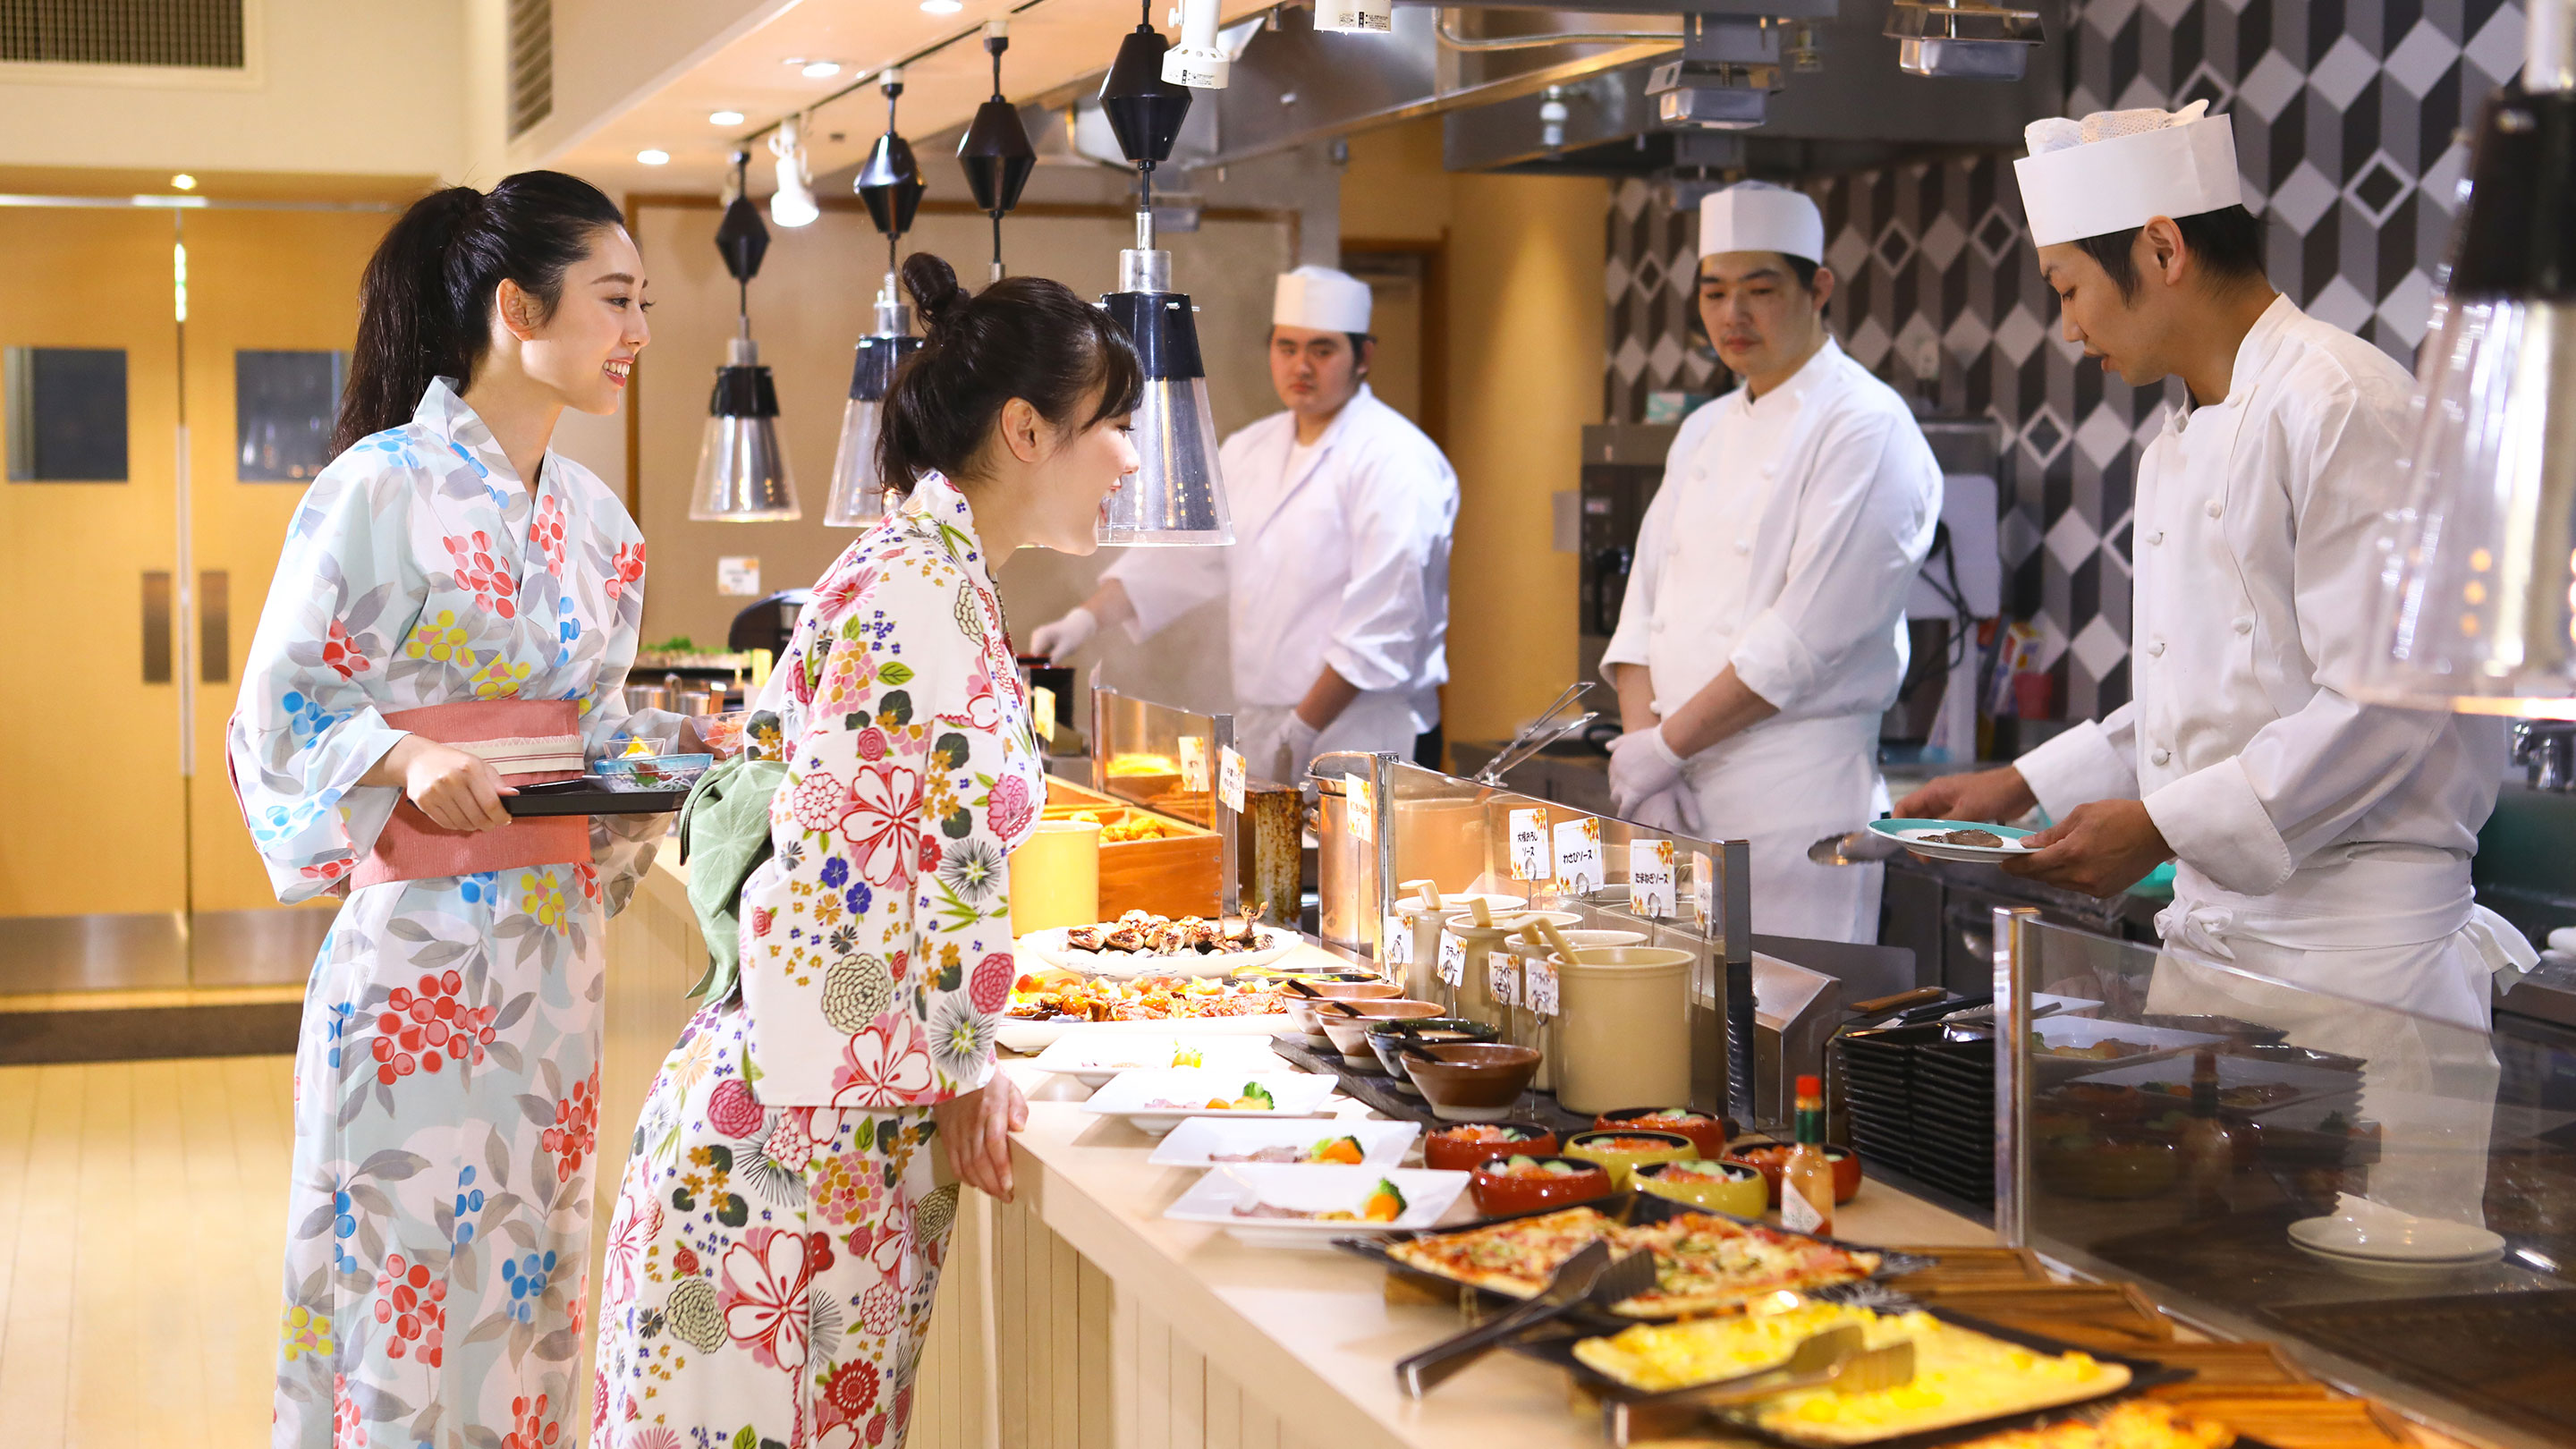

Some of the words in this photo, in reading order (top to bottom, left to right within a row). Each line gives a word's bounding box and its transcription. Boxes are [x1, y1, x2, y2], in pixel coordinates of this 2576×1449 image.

[1521, 846, 1535, 856] ソース
[1563, 849, 1593, 864] わさびソース
[1635, 872, 1669, 885] たまねぎソース
